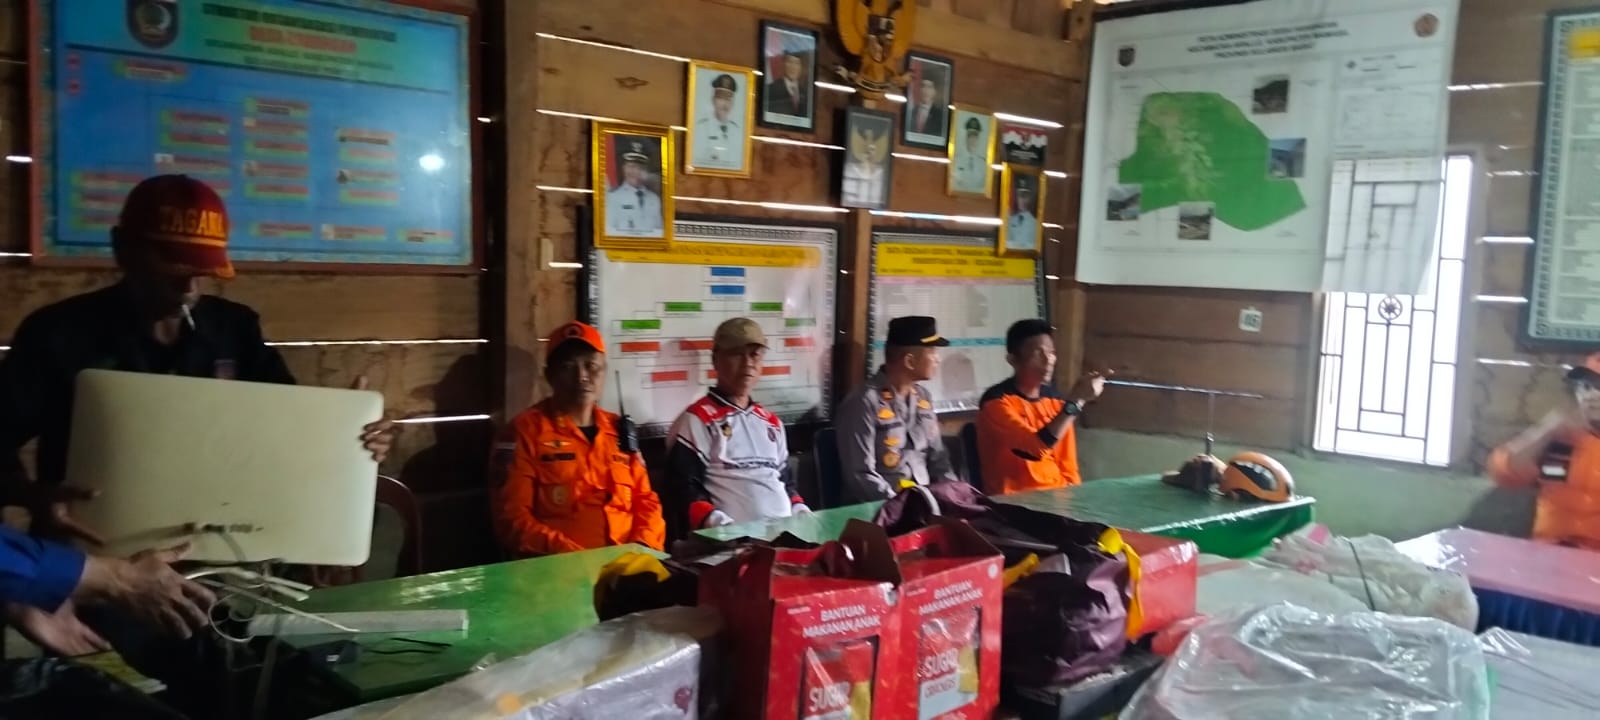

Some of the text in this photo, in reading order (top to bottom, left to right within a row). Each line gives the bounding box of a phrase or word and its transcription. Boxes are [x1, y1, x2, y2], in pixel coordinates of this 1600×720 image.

[934, 581, 972, 599] BANTUAN
[821, 605, 866, 622] BANTUAN
[919, 593, 960, 615] MAKANAN
[803, 615, 881, 638] MAKANAN ANAK
